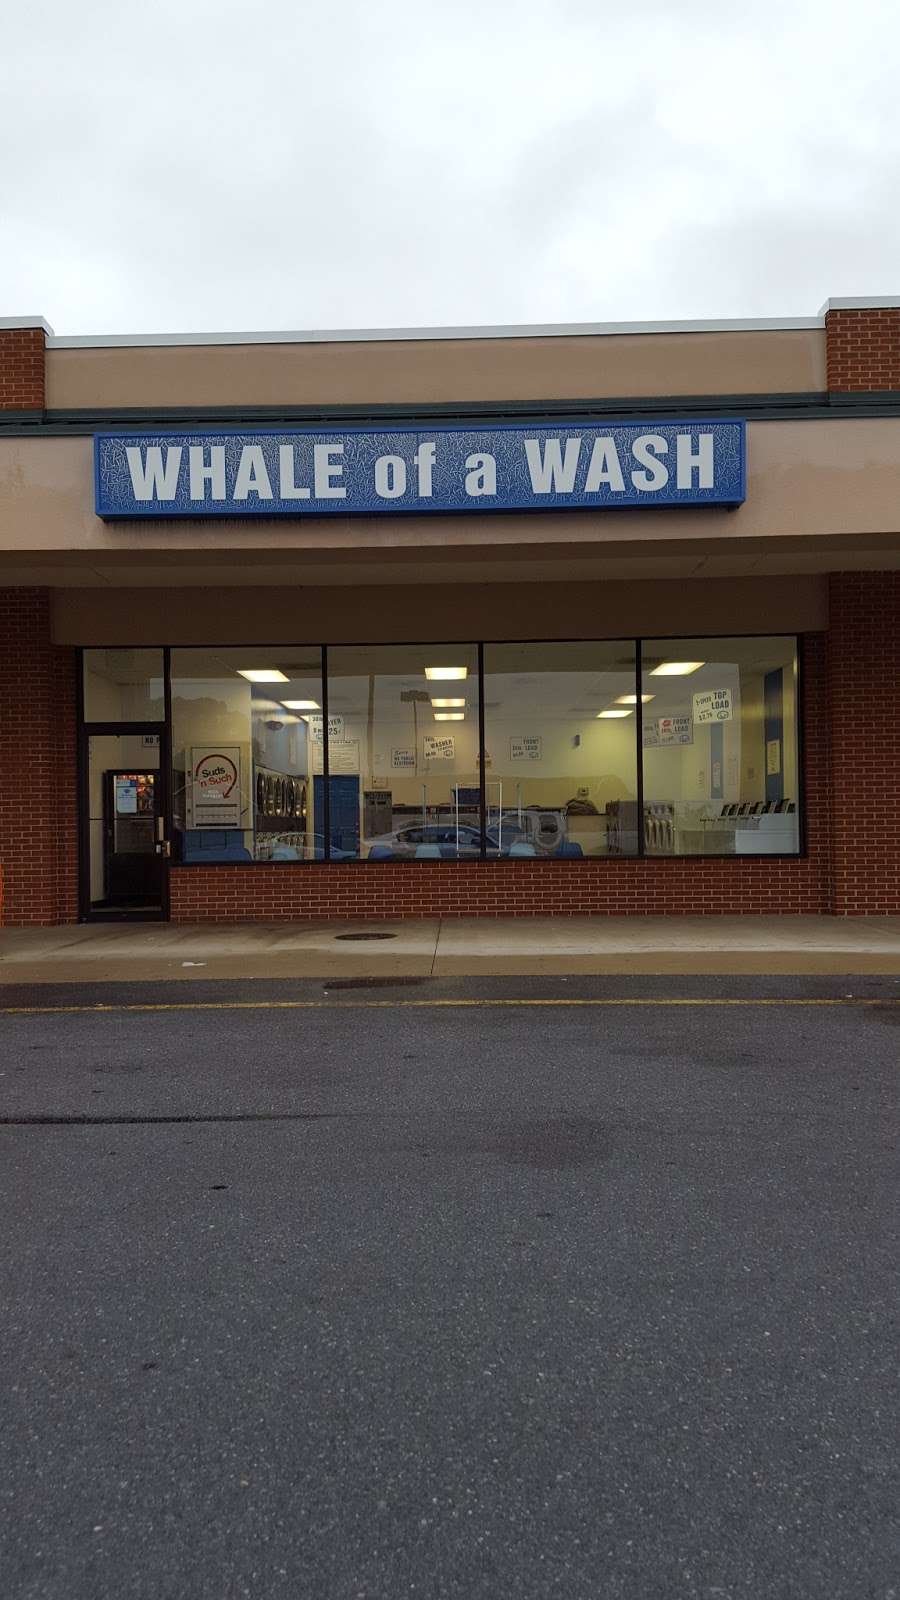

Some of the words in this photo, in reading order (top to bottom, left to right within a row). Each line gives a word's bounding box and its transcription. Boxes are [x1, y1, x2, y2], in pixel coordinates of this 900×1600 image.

[126, 444, 347, 501] WHALE
[374, 442, 436, 498] of
[465, 452, 497, 497] a
[525, 433, 714, 495] WASH
[713, 690, 727, 700] TOP
[711, 699, 729, 710] LOAD
[201, 767, 226, 778] Suds
[208, 773, 233, 786] Such
